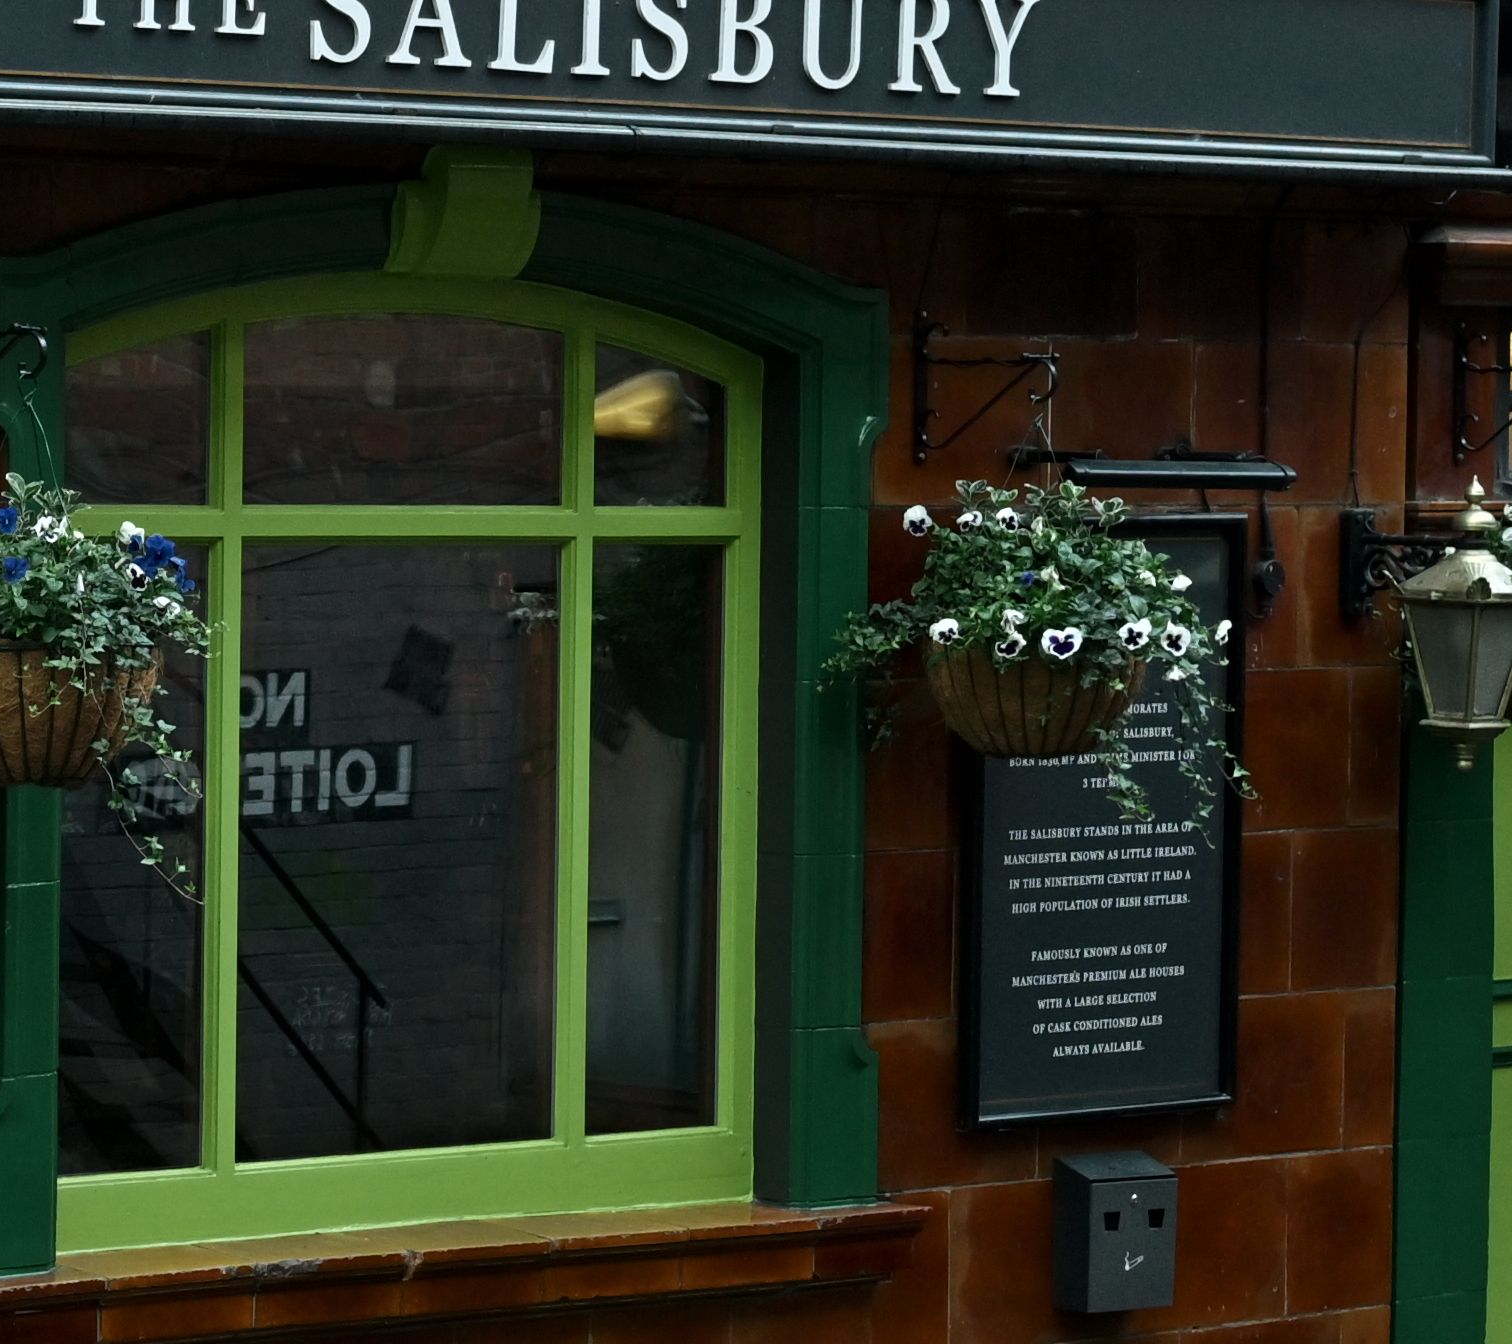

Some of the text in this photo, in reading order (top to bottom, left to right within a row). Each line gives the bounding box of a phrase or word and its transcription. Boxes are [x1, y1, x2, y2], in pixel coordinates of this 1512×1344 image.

[1077, 753, 1097, 765] AND
[1131, 750, 1175, 762] MINISTER
[1009, 829, 1028, 841] THE
[1031, 827, 1082, 840] SALISBURY
[1084, 825, 1119, 837] STANDS
[1122, 824, 1132, 835] IN
[1134, 823, 1153, 834] THE
[1155, 822, 1179, 833] AREA
[1004, 845, 1197, 865] MANCHESTER KNOWN AS LITTLE IRELAND.
[1009, 869, 1191, 890] IN THE NINETEENTH CENTURY IT HAD A
[1011, 893, 1191, 914] HIGH POPULATION OF IRISH SETTLERS.
[1031, 942, 1168, 962] FAMOUSLY KNOWN AS ONE OF
[1082, 969, 1127, 983] PREMIUM
[1129, 967, 1147, 979] ALE
[1149, 965, 1185, 978] HOUSES
[1037, 991, 1157, 1010] WITH A LARGE SELECTION
[1032, 1014, 1163, 1035] OF CASK CONDITIONED ALES
[1052, 1043, 1090, 1058] ALWAYS
